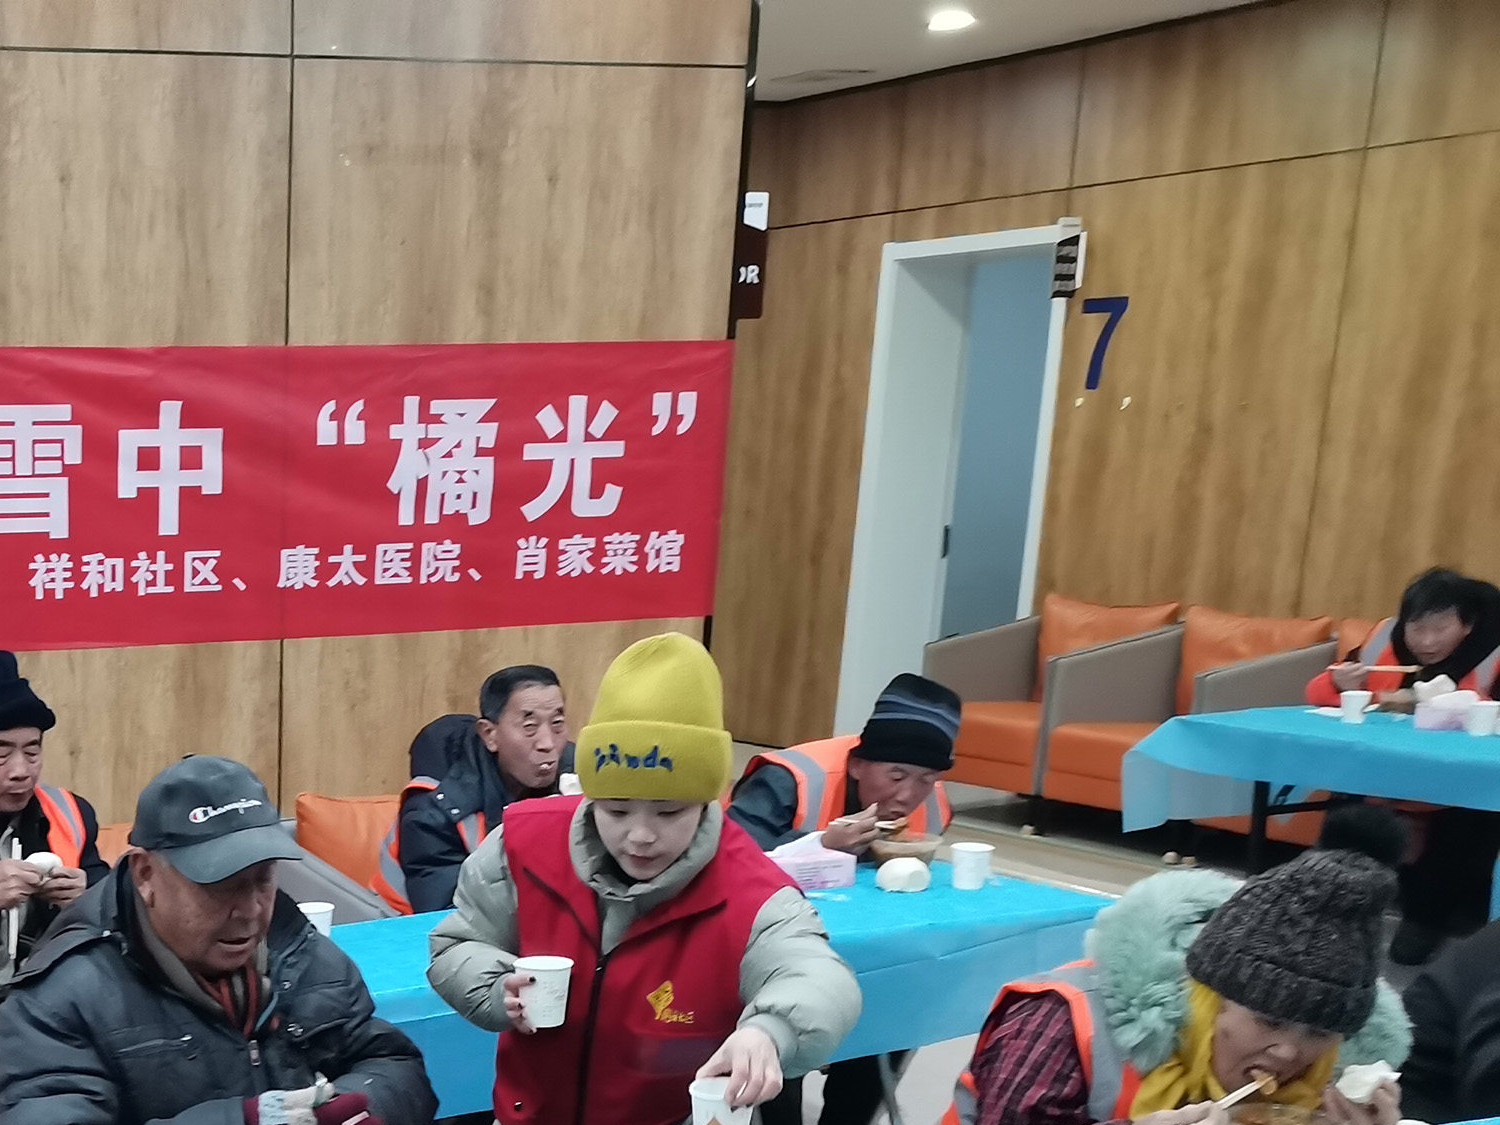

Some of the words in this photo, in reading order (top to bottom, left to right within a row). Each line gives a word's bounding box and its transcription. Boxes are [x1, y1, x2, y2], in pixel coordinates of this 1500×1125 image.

[1082, 296, 1129, 390] 7
[28, 529, 686, 600] 祥和社区、康太医院、肖家菜馆
